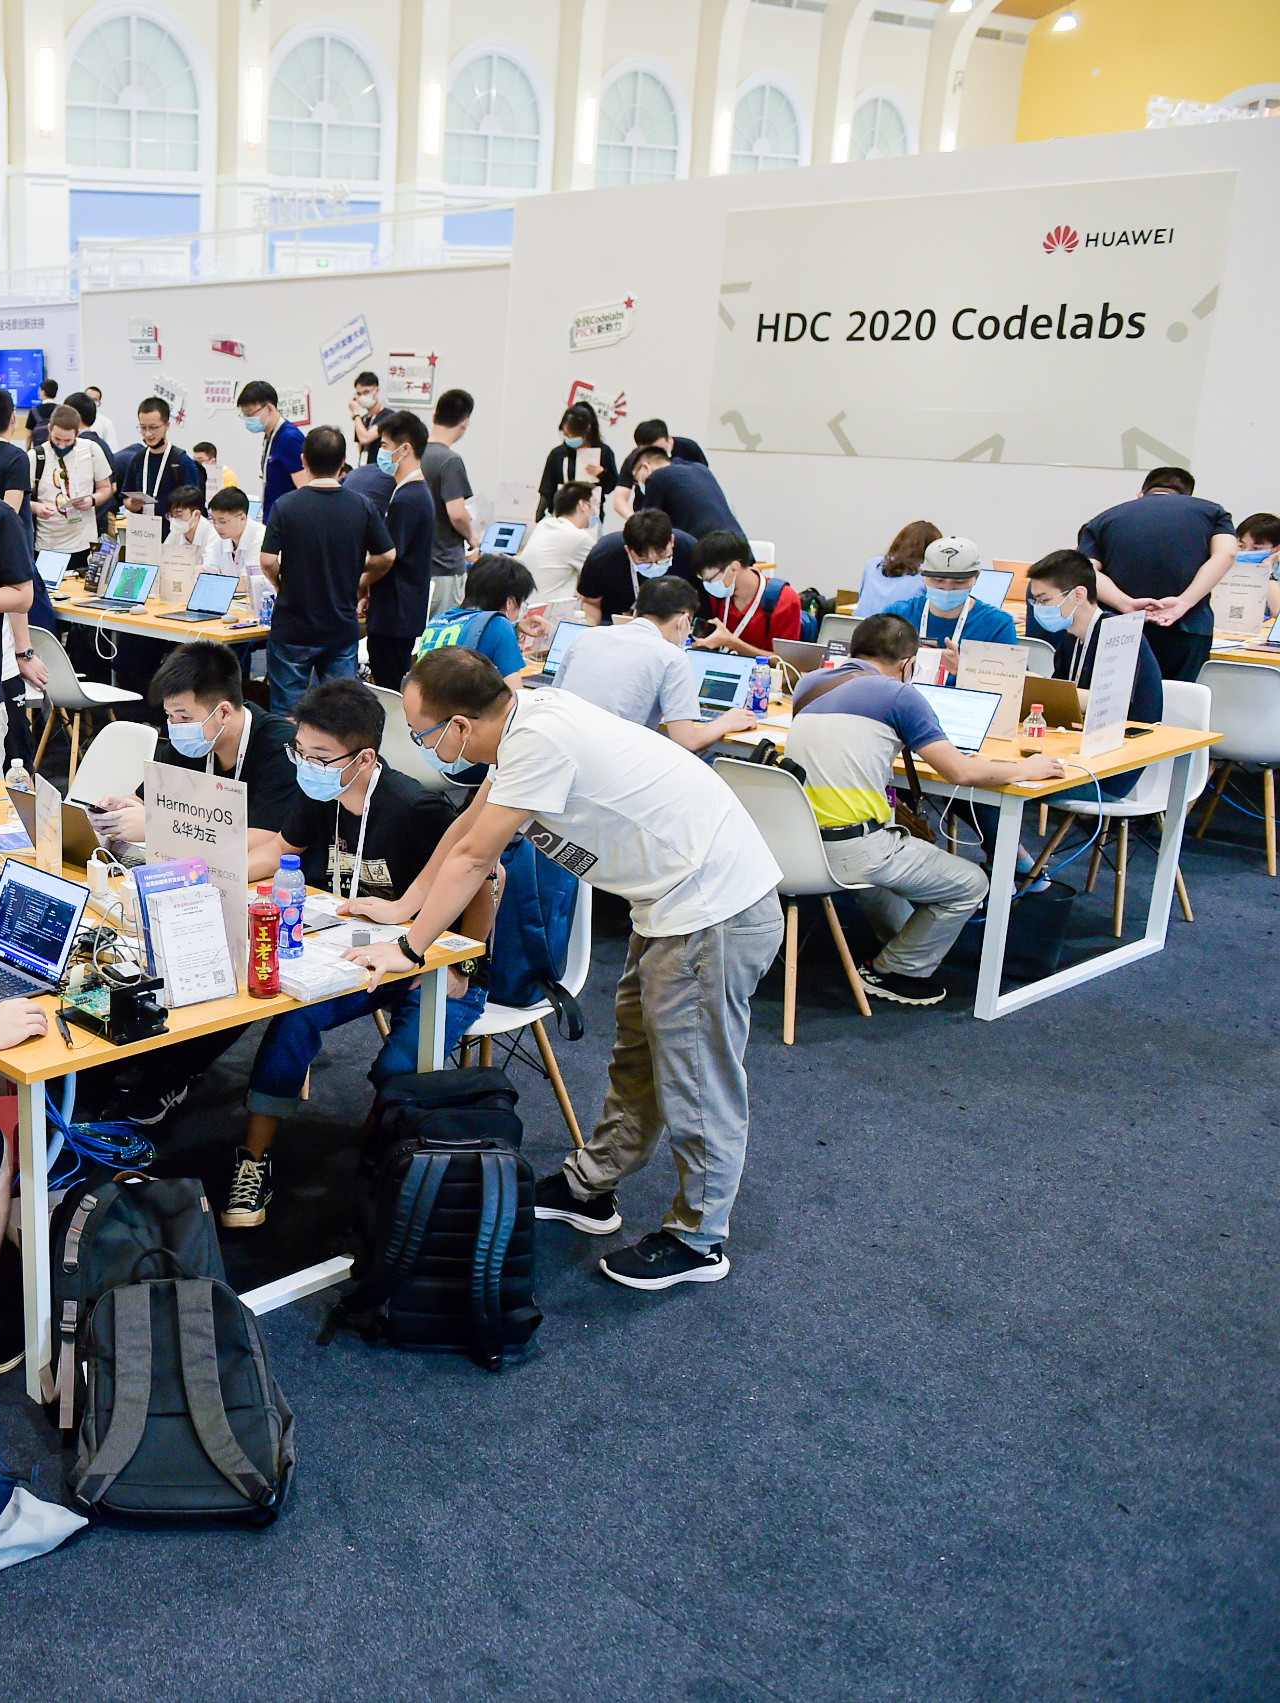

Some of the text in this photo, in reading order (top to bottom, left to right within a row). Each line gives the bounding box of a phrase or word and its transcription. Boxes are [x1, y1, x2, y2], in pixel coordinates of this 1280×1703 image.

[1085, 228, 1174, 248] HUAWEI
[756, 302, 1147, 342] HDC 2020 Codelabs
[389, 365, 405, 378] 华为
[404, 382, 431, 394] 不一般
[144, 531, 155, 539] Core
[1105, 633, 1135, 649] HMS Core
[992, 670, 1018, 679] Codelabs
[224, 786, 243, 795] HUAWEI
[156, 793, 233, 825] HarmonyOS
[172, 820, 217, 844] &华为云
[144, 871, 175, 881] HarmonyOS
[255, 926, 273, 982] 王老吉
